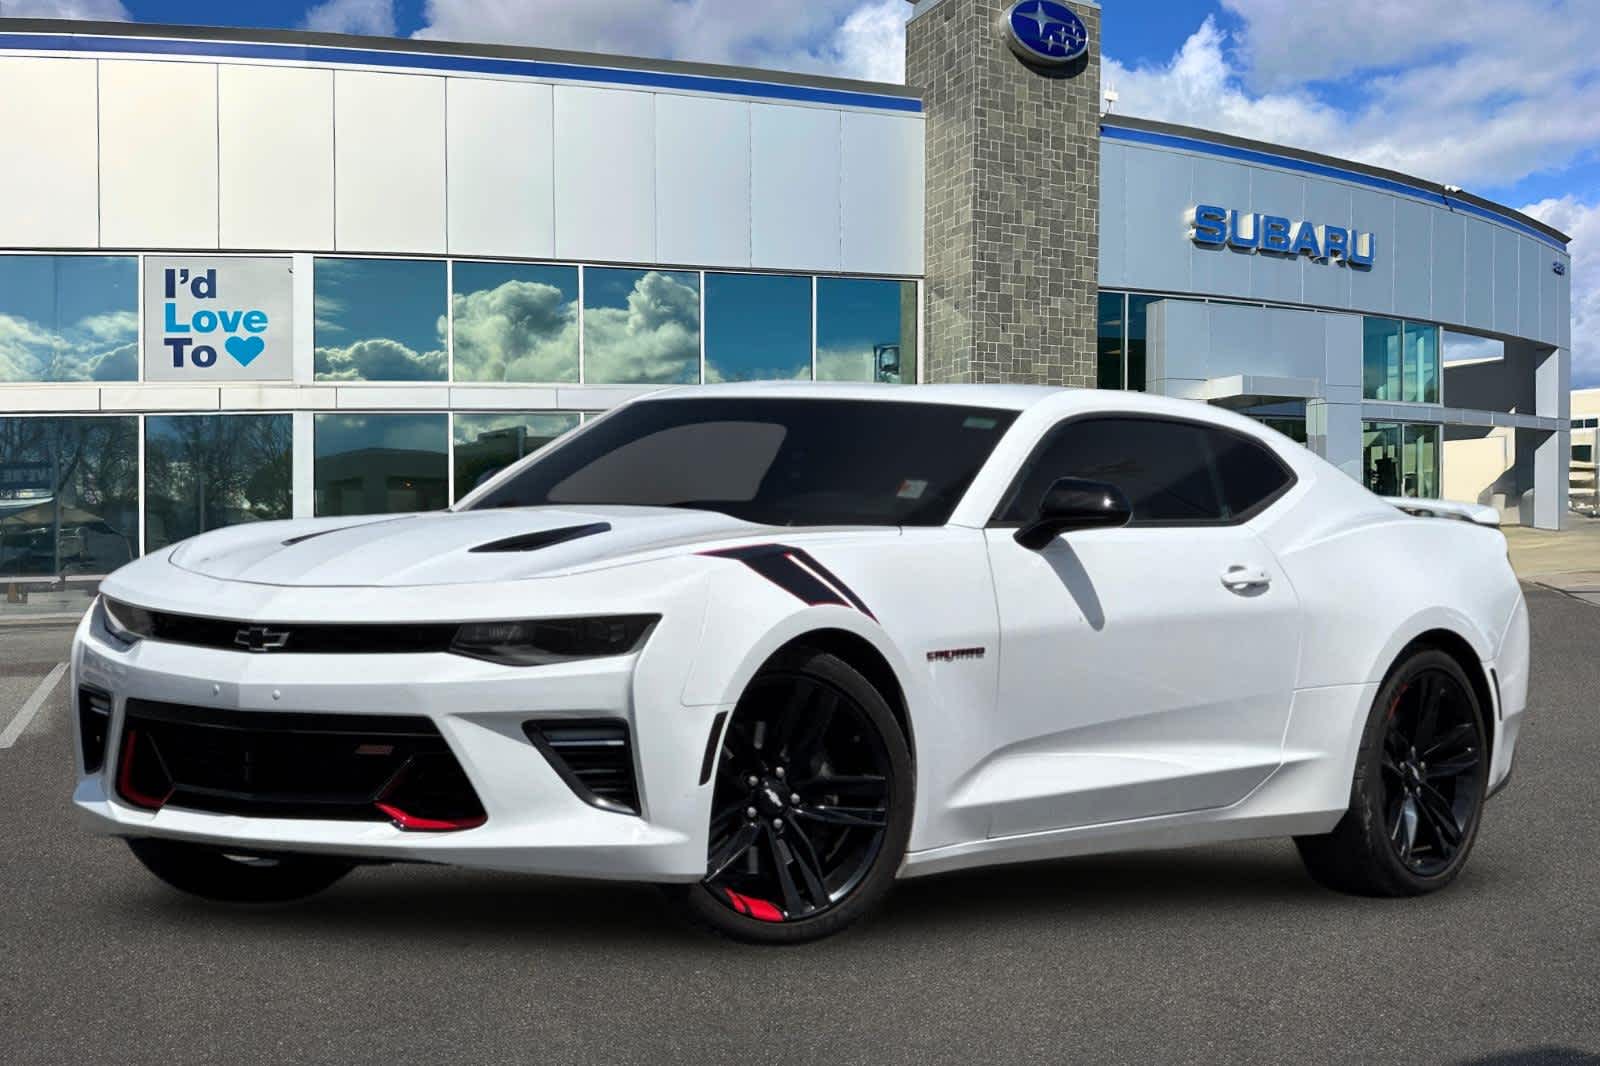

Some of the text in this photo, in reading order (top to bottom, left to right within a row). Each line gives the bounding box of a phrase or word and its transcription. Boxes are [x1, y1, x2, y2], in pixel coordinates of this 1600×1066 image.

[1192, 204, 1376, 268] SUBARU
[164, 268, 217, 299] I'd
[164, 302, 269, 333] Love
[163, 337, 218, 368] To
